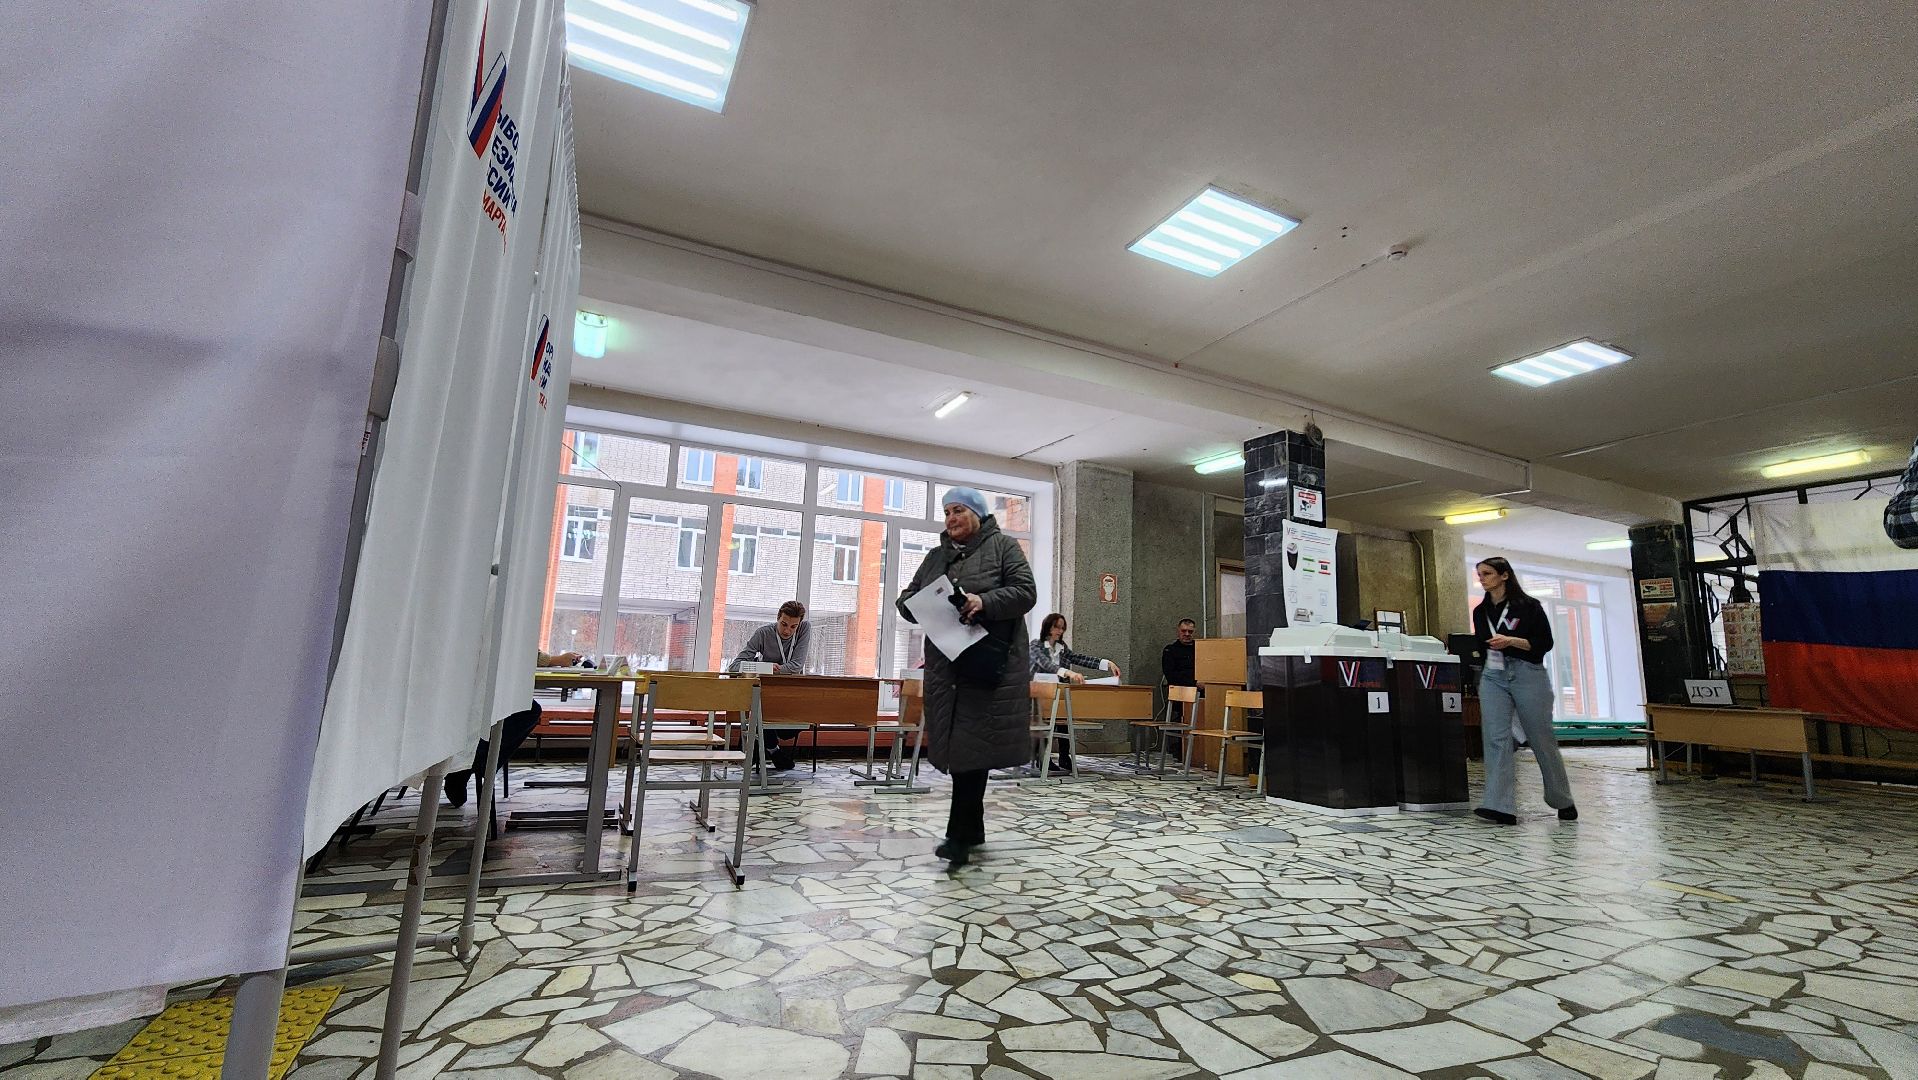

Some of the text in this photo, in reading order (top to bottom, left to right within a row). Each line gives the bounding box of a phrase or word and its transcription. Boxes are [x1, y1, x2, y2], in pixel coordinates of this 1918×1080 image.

[1691, 686, 1723, 699] ДЭГ
[1376, 696, 1381, 709] 1
[1449, 696, 1456, 709] 2
